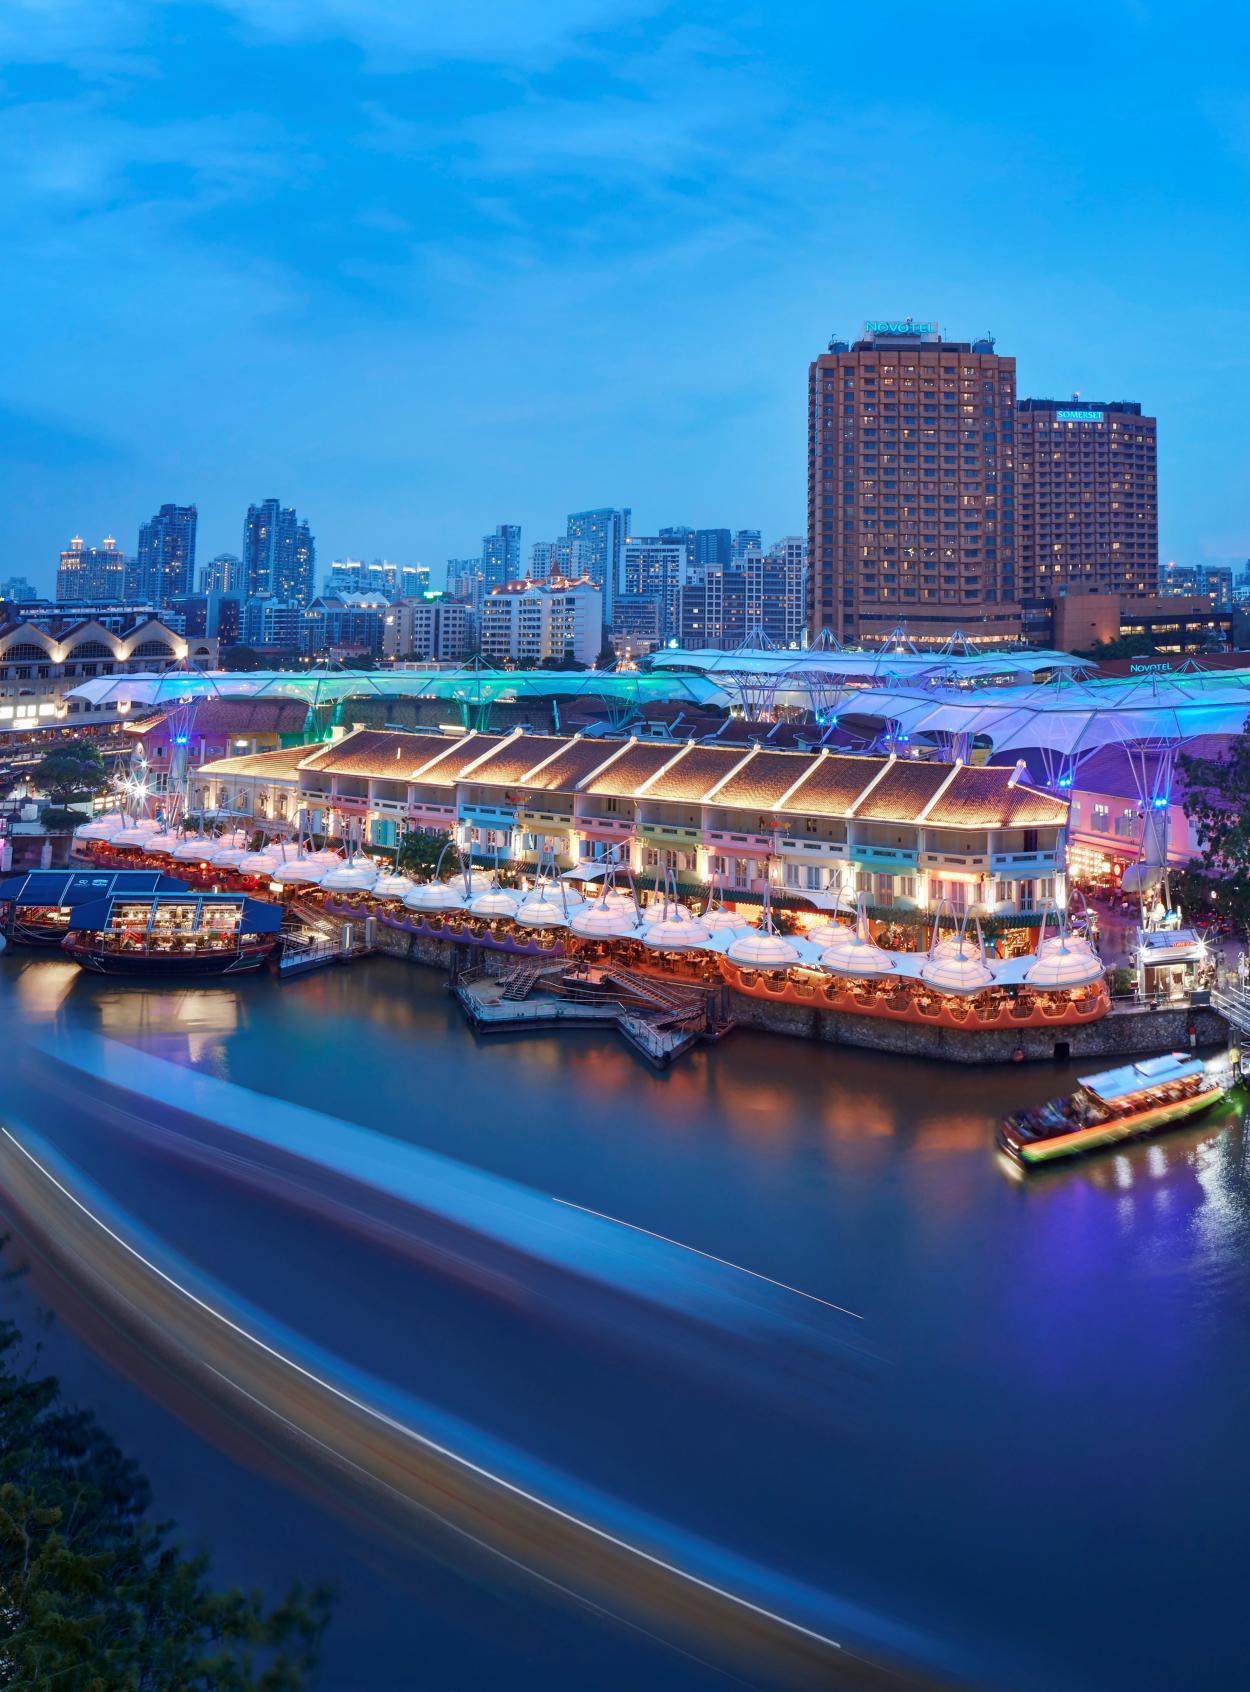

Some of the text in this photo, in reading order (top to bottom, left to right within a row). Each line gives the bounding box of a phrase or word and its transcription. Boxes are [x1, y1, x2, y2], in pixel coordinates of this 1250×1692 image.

[866, 321, 936, 334] NOVOTEL
[1058, 411, 1102, 419] SOMERSET
[1131, 662, 1172, 673] NOVOTEL
